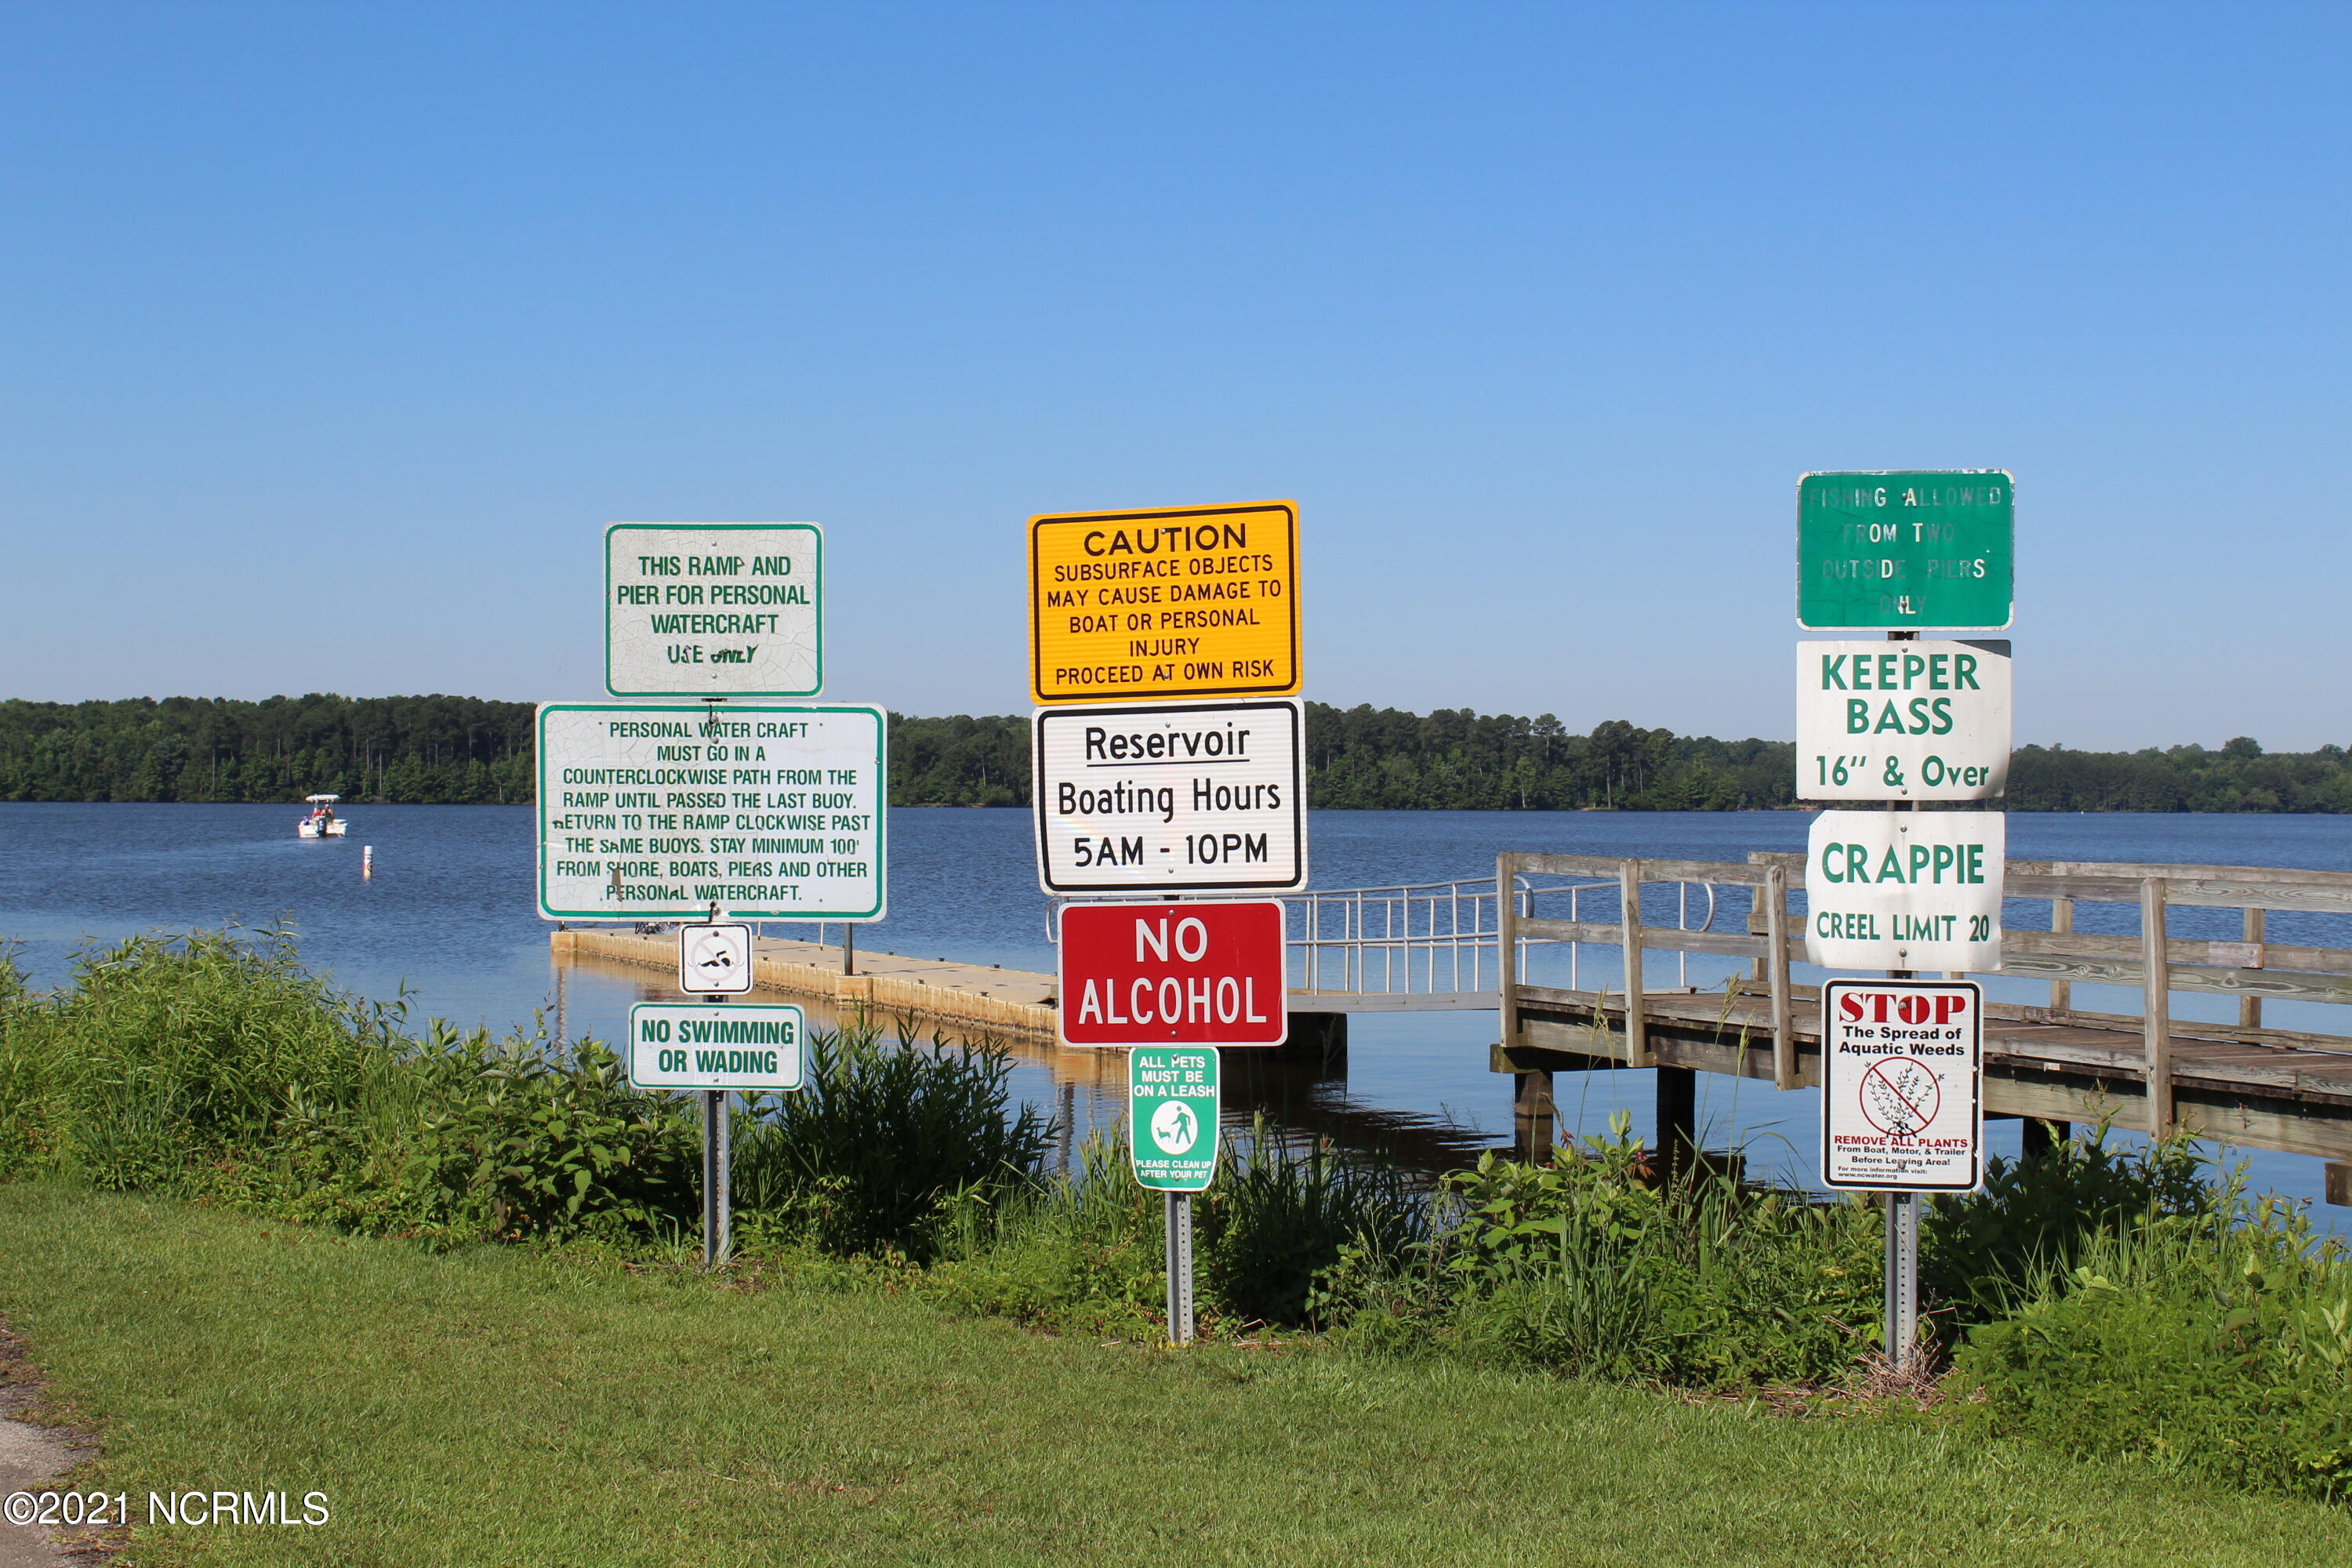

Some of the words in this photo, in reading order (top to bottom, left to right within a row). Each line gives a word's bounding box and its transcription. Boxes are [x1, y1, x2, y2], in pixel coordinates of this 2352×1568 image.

[1084, 523, 1246, 557] CAUTION
[638, 556, 681, 576] THIS
[689, 556, 745, 576] RAMP
[752, 556, 791, 576] AND
[1054, 559, 1180, 582] SUBSURFACE
[1189, 554, 1273, 575] OBJECTS
[618, 585, 659, 604] PIER
[666, 585, 703, 604] FOR
[711, 585, 810, 604] PERSONAL
[1047, 590, 1088, 608] MAY
[1098, 586, 1162, 605] CAUSE
[1171, 582, 1250, 602] DAMAGE
[1259, 579, 1281, 597] TO
[651, 614, 779, 633] WATERCRAFT
[1070, 615, 1118, 633] BOAT
[1127, 613, 1152, 630] OR
[1161, 608, 1260, 629] PERSONAL
[667, 644, 703, 664] USE
[1130, 637, 1200, 657] INJURY
[1057, 665, 1142, 685] PROCEED
[1152, 664, 1175, 681] AT
[1184, 662, 1223, 681] OWN
[1232, 659, 1274, 678] RISK
[1822, 654, 1980, 690] KEEPER
[1847, 698, 1953, 735] BASS
[609, 722, 692, 738] PERSONAL
[698, 722, 751, 739] WATER
[757, 722, 808, 739] CRAFT
[1086, 722, 1250, 760] Reservoir
[657, 746, 702, 761] MUST
[707, 746, 728, 761] GO
[735, 746, 749, 761] IN
[755, 746, 765, 761] A
[563, 768, 728, 785] COUNTERCLOCKWISE
[733, 769, 771, 785] PATH
[777, 769, 822, 785] FROM
[827, 770, 856, 785] THE
[1883, 756, 1904, 786] &
[1922, 755, 1989, 787] Over
[564, 793, 608, 808] RAMP
[615, 793, 660, 808] UNTIL
[667, 793, 726, 808] PASSED
[732, 793, 761, 808] THE
[768, 793, 806, 808] LAST
[812, 793, 856, 809] BUOY.
[1059, 780, 1173, 823] Boating
[1193, 778, 1280, 811] Hours
[622, 815, 641, 831] TO
[648, 815, 677, 829] THE
[684, 815, 730, 829] RAMP
[735, 815, 826, 831] CLOCKWISE
[832, 815, 870, 831] PAST
[566, 838, 593, 853] THE
[600, 838, 644, 853] SAME
[649, 838, 703, 853] BUOYS.
[710, 839, 746, 853] STAY
[752, 839, 823, 854] MINIMUM
[829, 839, 859, 855] 100'
[1075, 836, 1143, 867] 5AM
[1186, 833, 1267, 864] 10PM
[557, 862, 600, 877] FROM
[607, 862, 662, 879] SHORE,
[670, 862, 721, 879] BOATS,
[728, 862, 772, 877] PIERS
[778, 862, 811, 877] AND
[816, 862, 867, 877] OTHER
[1822, 842, 1984, 884] CRAPPIE
[606, 885, 688, 900] PERSONAL
[695, 885, 801, 901] WATERCRAFT.
[1817, 911, 1880, 940] CREEL
[1893, 914, 1957, 942] LIMIT
[1969, 914, 1989, 942] 20
[1136, 916, 1207, 963] NO
[1078, 976, 1266, 1025] ALCOHOL
[1839, 993, 1965, 1025] STOP
[642, 1019, 670, 1043] NO
[678, 1020, 793, 1044] SWIMMING
[1842, 1025, 1875, 1038] The
[1881, 1026, 1940, 1041] Spread
[1945, 1028, 1962, 1040] of
[1839, 1041, 1904, 1056] Aquatic
[1910, 1044, 1965, 1055] Weeds
[659, 1049, 687, 1073] OR
[696, 1051, 777, 1073] WADING
[1139, 1056, 1165, 1068] ALL
[1171, 1057, 1205, 1068] PETS
[1142, 1071, 1179, 1083] MUST
[1185, 1071, 1203, 1083] BE
[1134, 1085, 1153, 1097] ON
[1158, 1085, 1167, 1097] A
[1171, 1085, 1214, 1098] LEASH
[1835, 1135, 1886, 1145] REMOVE
[1891, 1137, 1914, 1146] ALL
[1918, 1138, 1968, 1147] PLANTS
[1864, 1146, 1888, 1155] Boat,
[1170, 1170, 1192, 1178] YOUR
